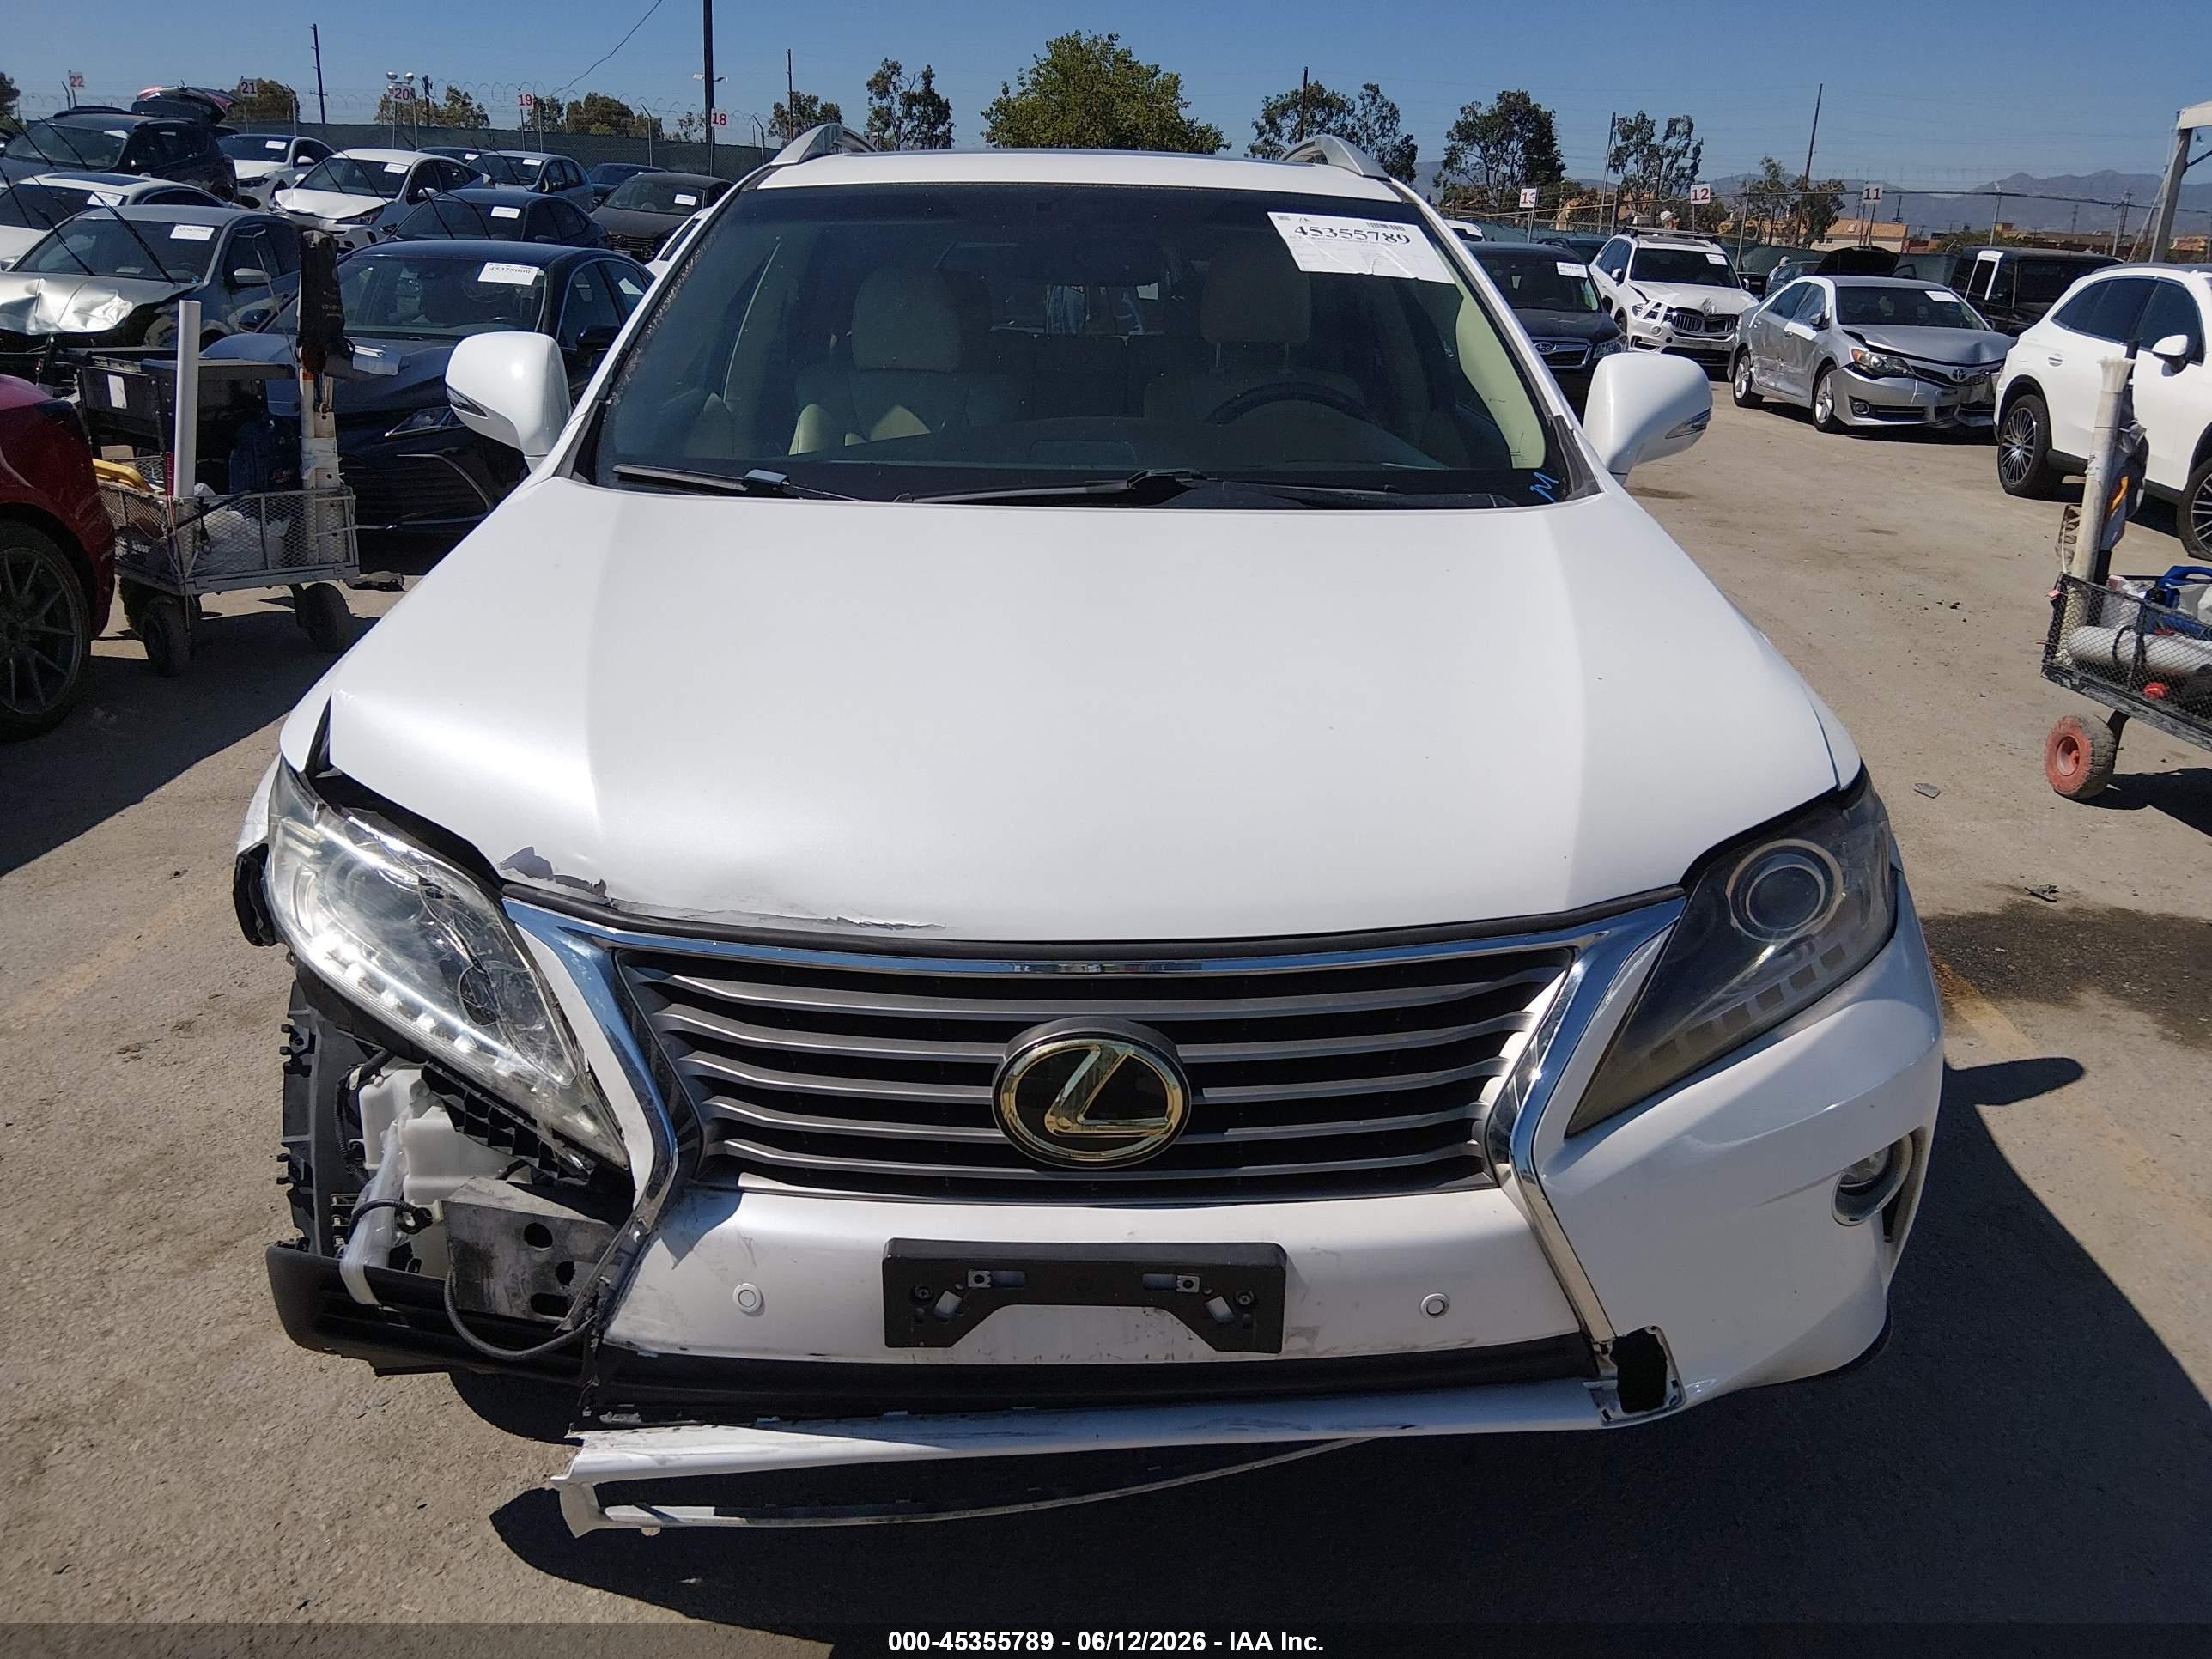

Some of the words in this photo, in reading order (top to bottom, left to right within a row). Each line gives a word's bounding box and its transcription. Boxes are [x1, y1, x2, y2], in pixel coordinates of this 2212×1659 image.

[70, 75, 85, 87] 22
[241, 82, 257, 94] 21
[394, 87, 410, 100] 20
[518, 94, 532, 106] 19
[713, 112, 726, 125] 18
[1692, 188, 1709, 201] 12
[1863, 187, 1881, 200] 11
[1294, 225, 1411, 245] 45355789
